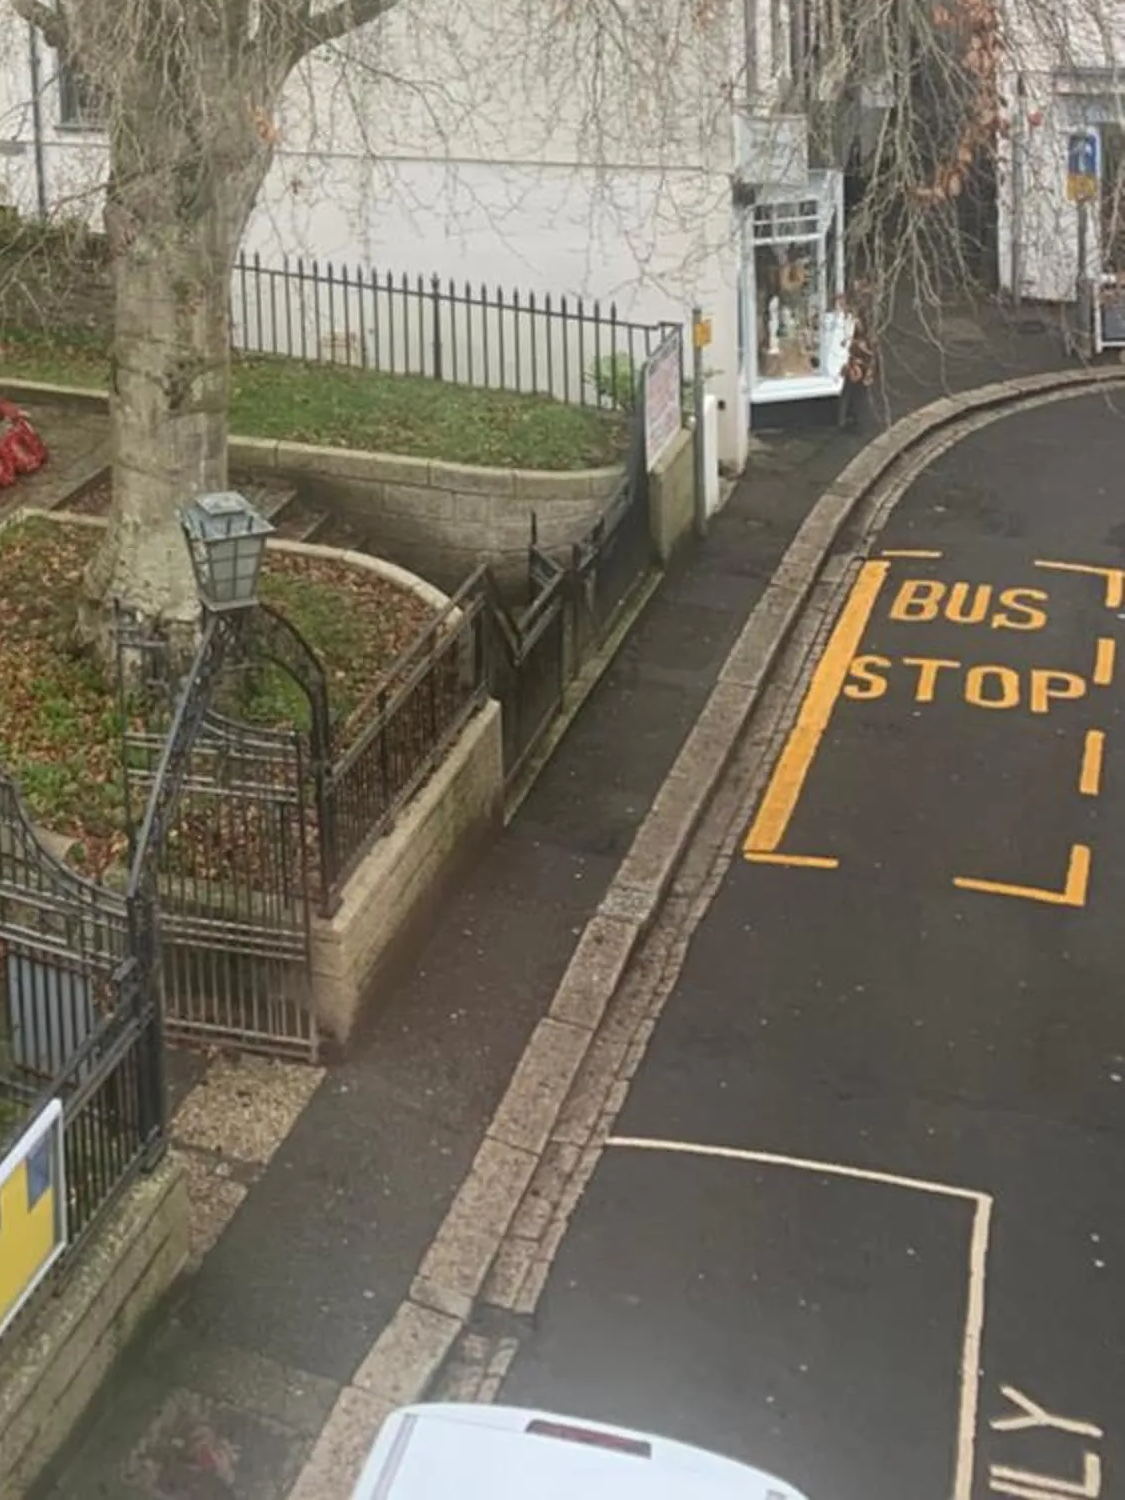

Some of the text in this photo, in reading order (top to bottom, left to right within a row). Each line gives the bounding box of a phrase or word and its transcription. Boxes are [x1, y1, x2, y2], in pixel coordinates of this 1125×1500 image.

[889, 579, 1049, 631] BUS
[843, 655, 1087, 714] STOP
[989, 1385, 1104, 1500] LY
